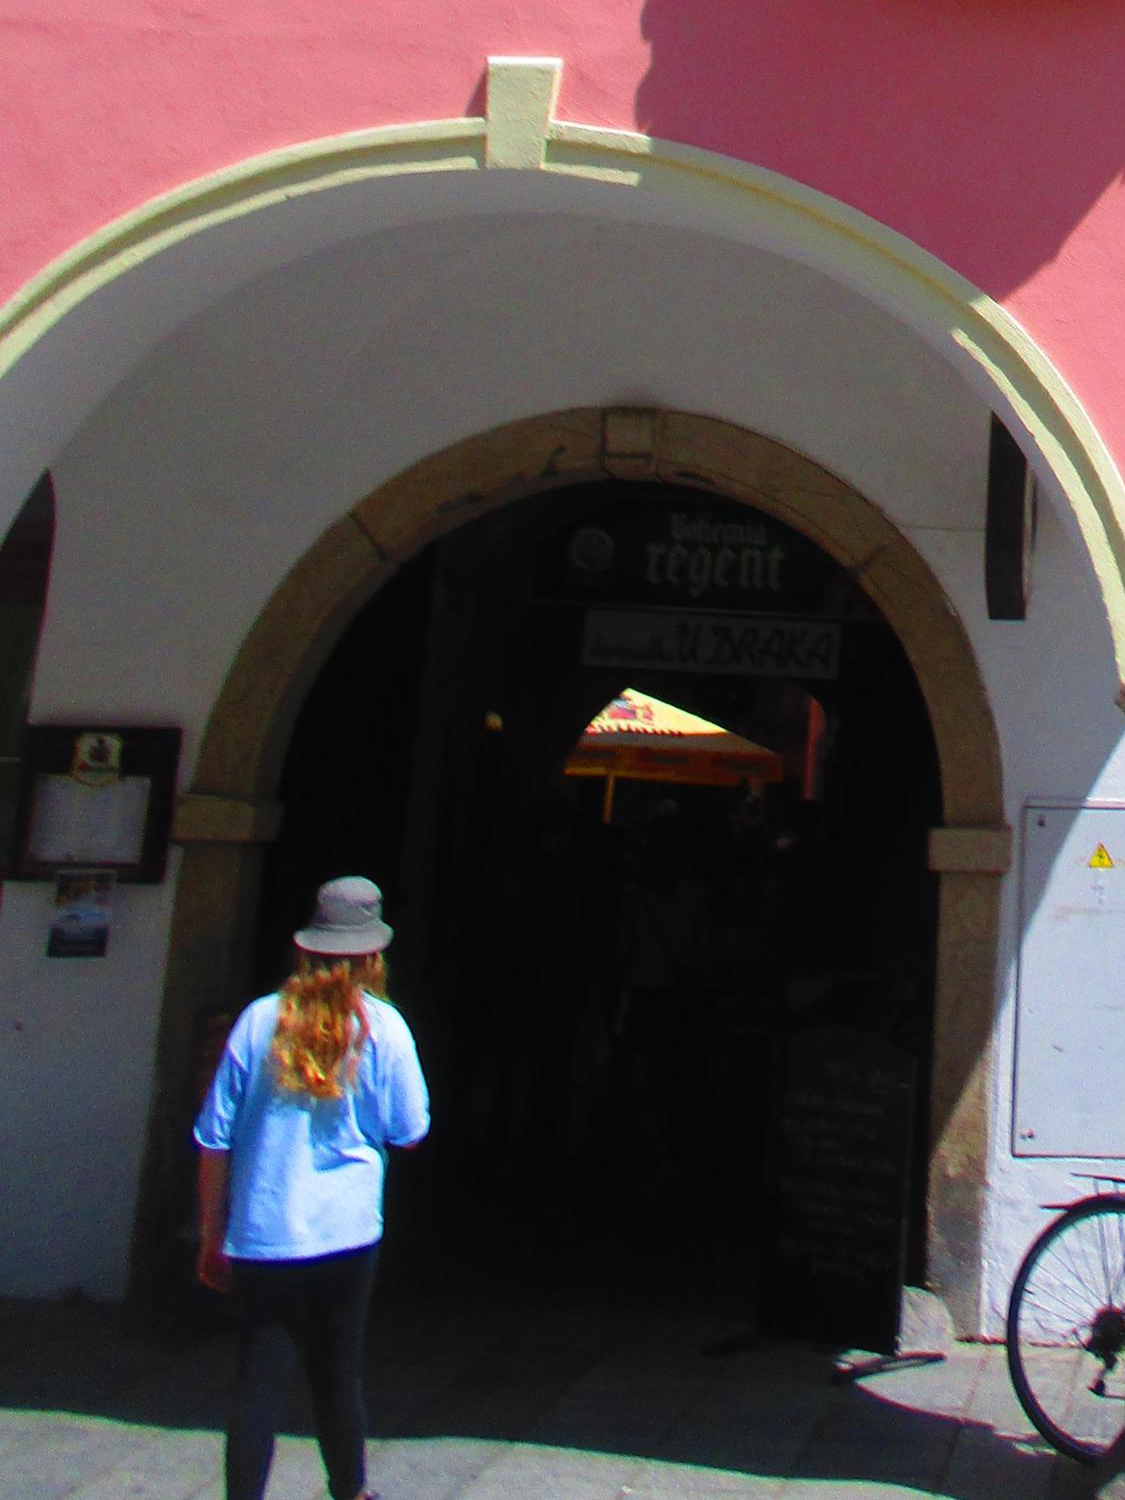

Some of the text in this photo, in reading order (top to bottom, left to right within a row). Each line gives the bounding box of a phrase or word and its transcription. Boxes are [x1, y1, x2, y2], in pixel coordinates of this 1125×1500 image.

[645, 542, 785, 597] regent
[676, 620, 703, 663] U
[705, 623, 834, 670] DRAKA
